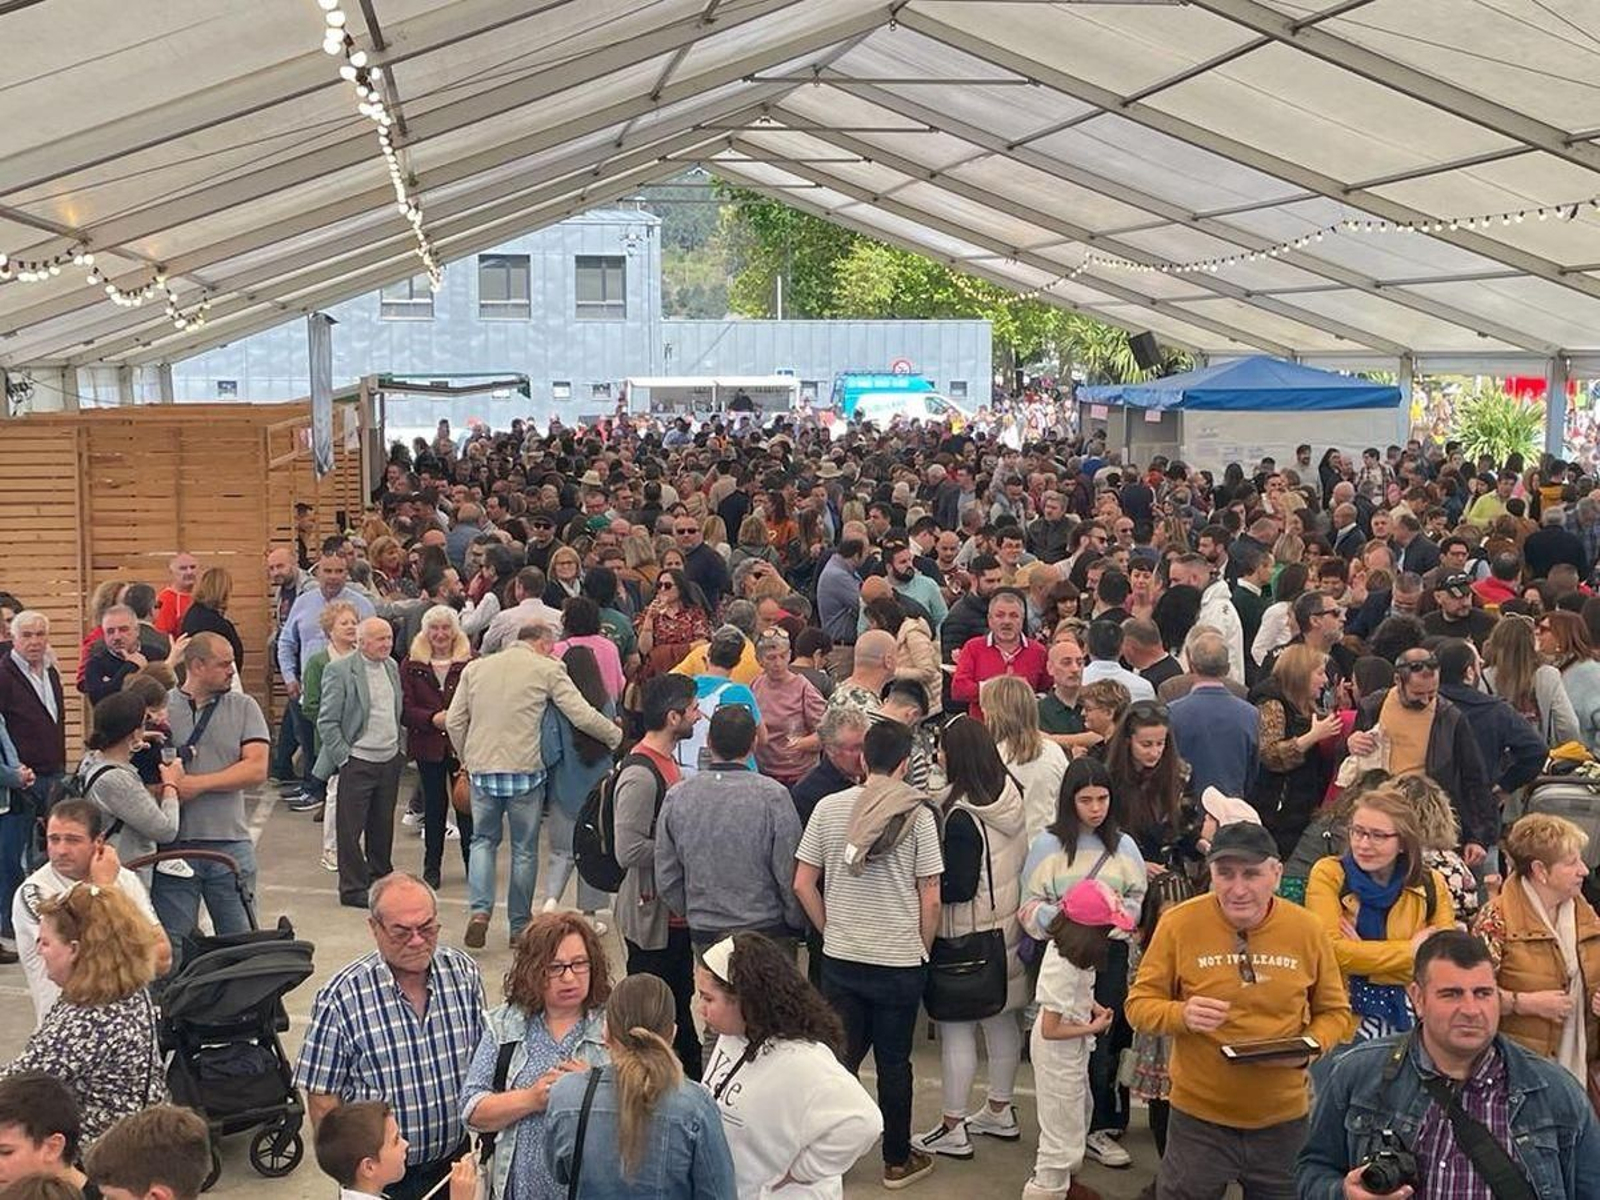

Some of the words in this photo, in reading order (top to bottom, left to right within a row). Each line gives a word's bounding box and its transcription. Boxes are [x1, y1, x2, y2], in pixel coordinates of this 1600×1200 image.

[1198, 955, 1223, 968] NOT
[1226, 954, 1247, 965] IV
[1252, 954, 1298, 969] LEAGUE
